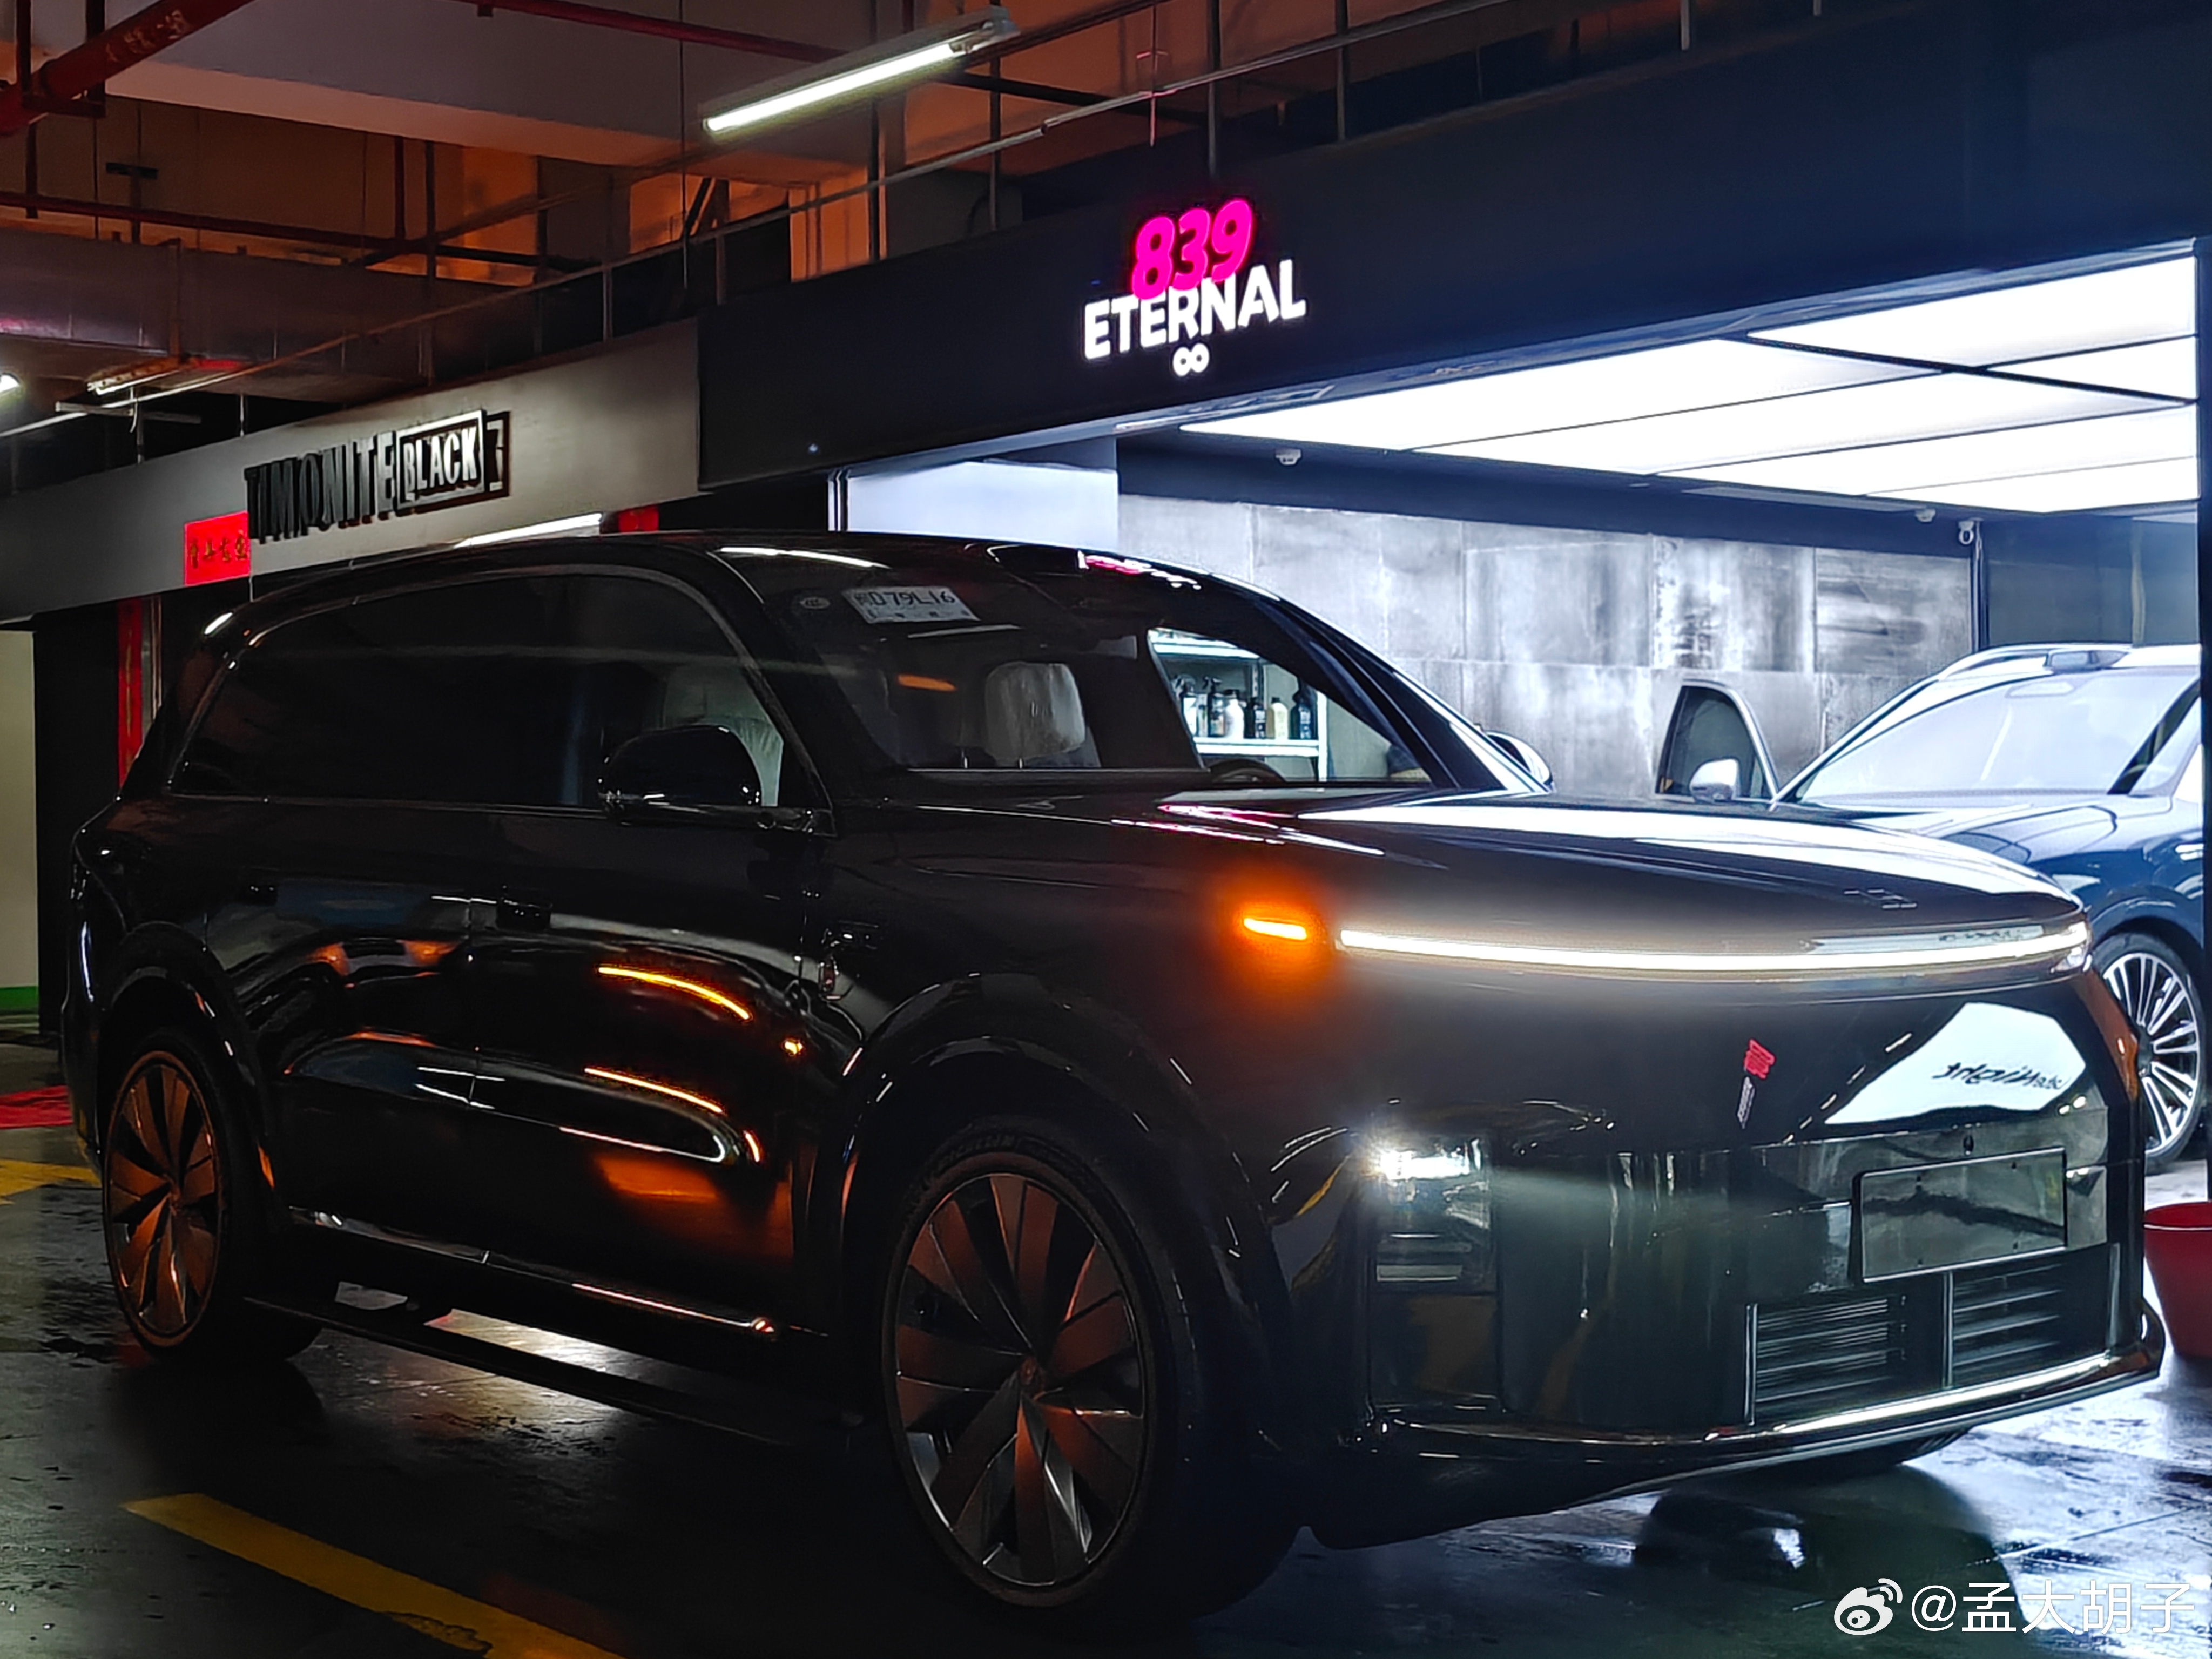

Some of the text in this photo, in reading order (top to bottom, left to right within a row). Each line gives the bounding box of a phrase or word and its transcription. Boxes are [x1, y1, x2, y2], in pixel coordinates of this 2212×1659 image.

[1132, 199, 1253, 300] 839
[1084, 259, 1307, 360] ETERNAL
[403, 427, 478, 496] BLACK
